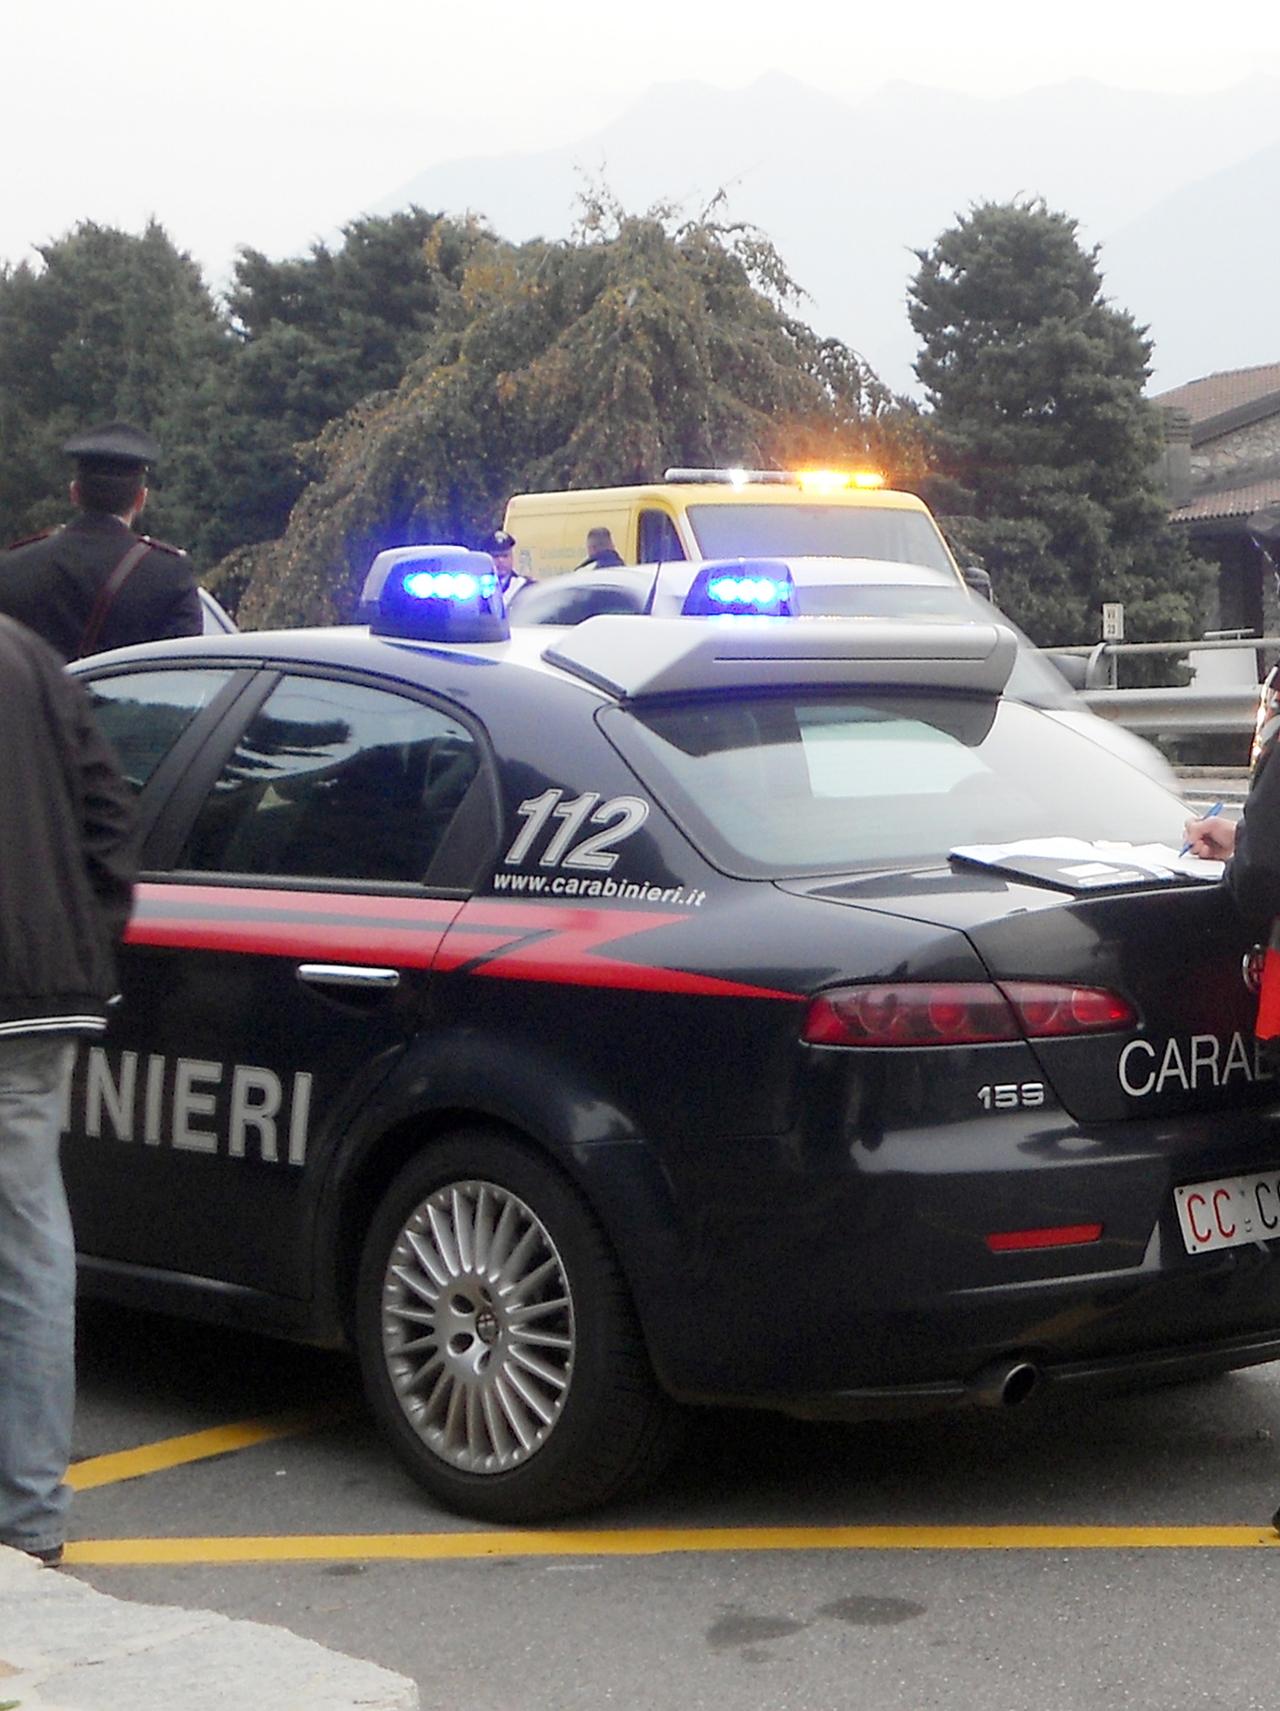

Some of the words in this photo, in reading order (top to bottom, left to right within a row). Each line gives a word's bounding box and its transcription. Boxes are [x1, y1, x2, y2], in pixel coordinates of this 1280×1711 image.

[504, 787, 650, 872] 112
[493, 871, 707, 907] www.carabinieri.it
[976, 1081, 1045, 1111] 159
